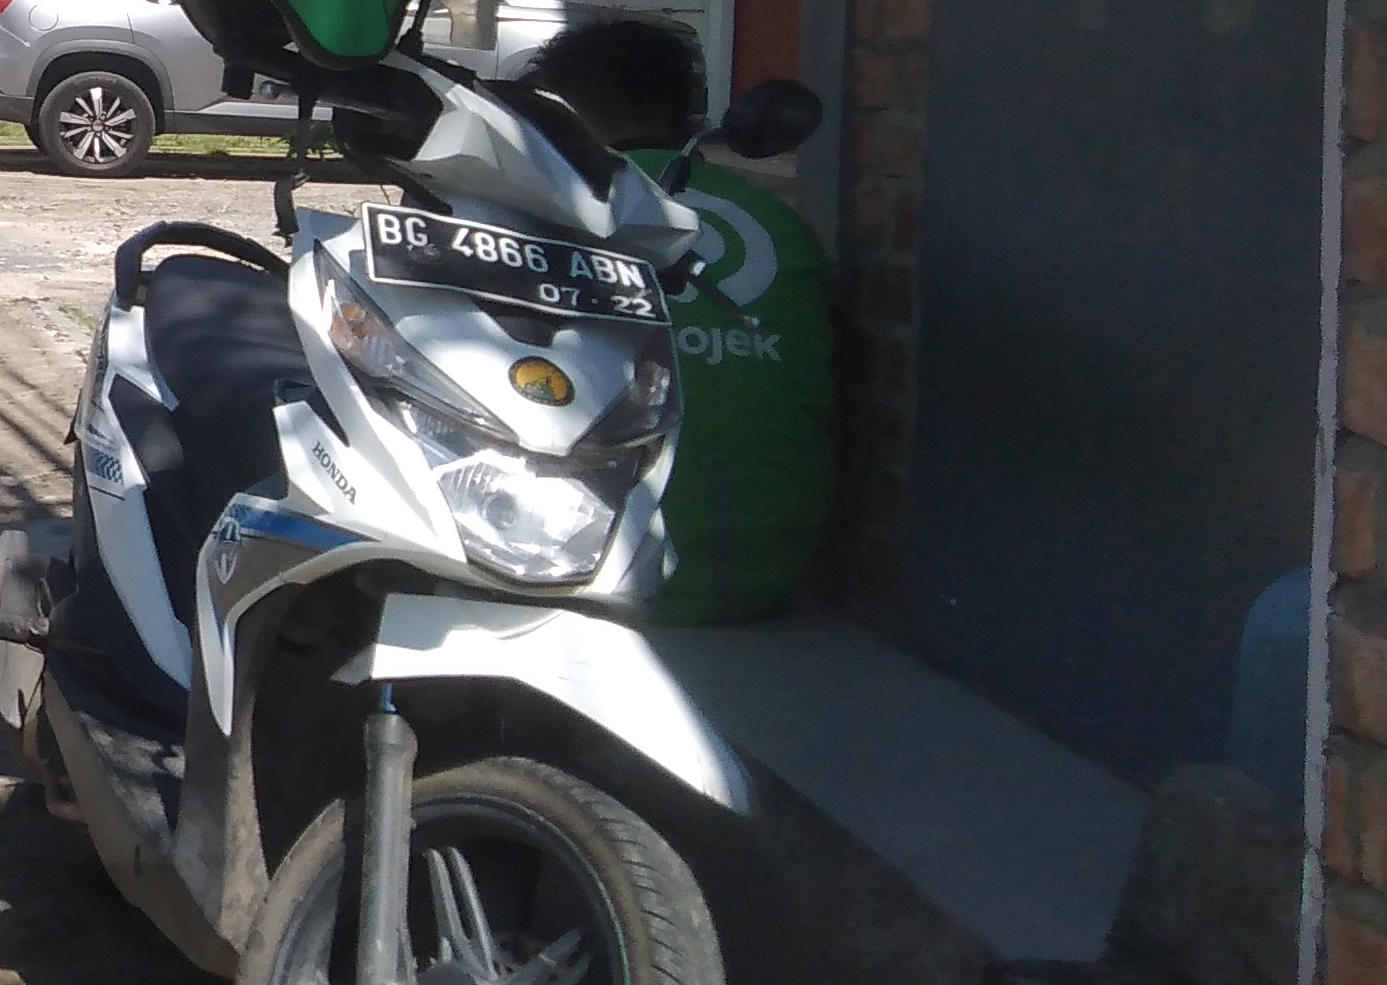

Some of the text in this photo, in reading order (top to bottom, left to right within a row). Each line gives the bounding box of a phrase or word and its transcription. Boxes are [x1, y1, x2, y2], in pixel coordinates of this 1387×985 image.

[377, 213, 647, 289] BG 4866 ABN
[677, 326, 783, 365] ojek
[312, 440, 357, 506] HONDA
